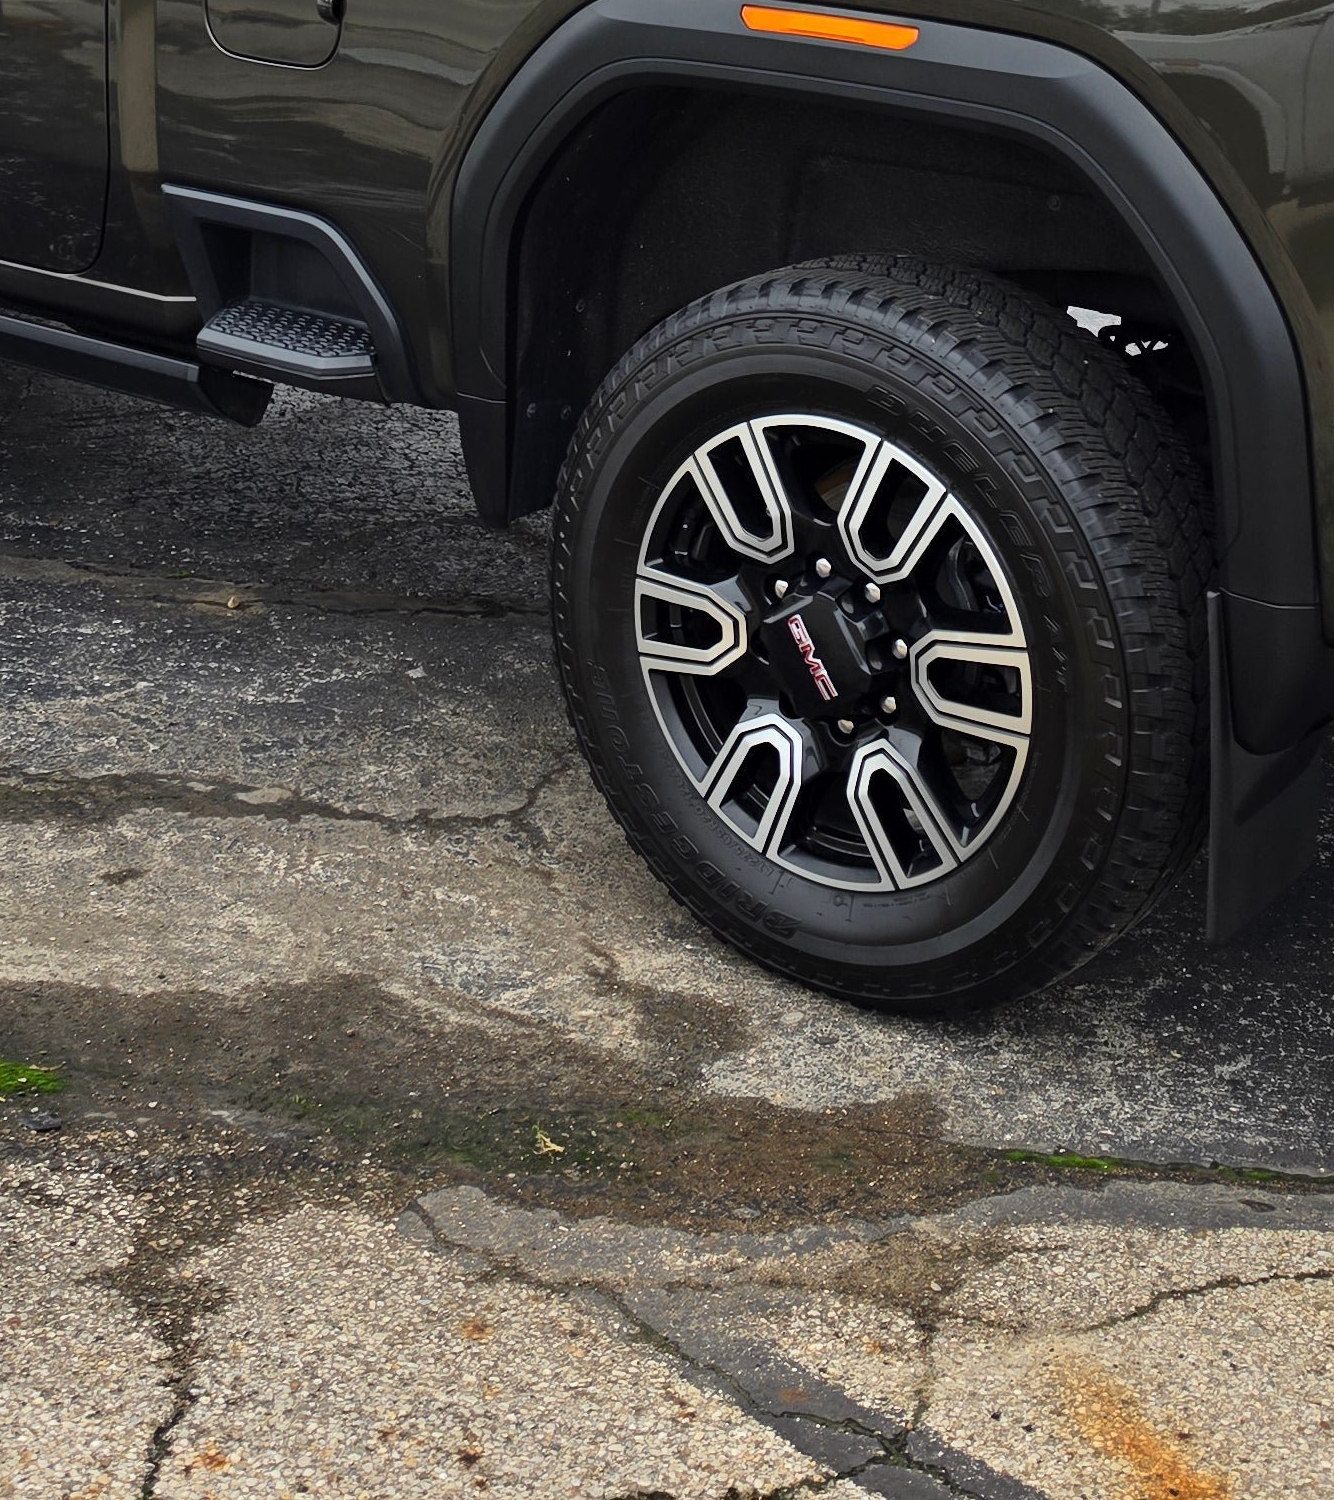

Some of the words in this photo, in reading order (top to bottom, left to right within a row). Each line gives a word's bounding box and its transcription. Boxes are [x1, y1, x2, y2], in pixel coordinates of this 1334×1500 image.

[866, 380, 1054, 600] DUELER
[787, 613, 839, 701] GMC
[584, 658, 802, 940] BRIDGESTONE
